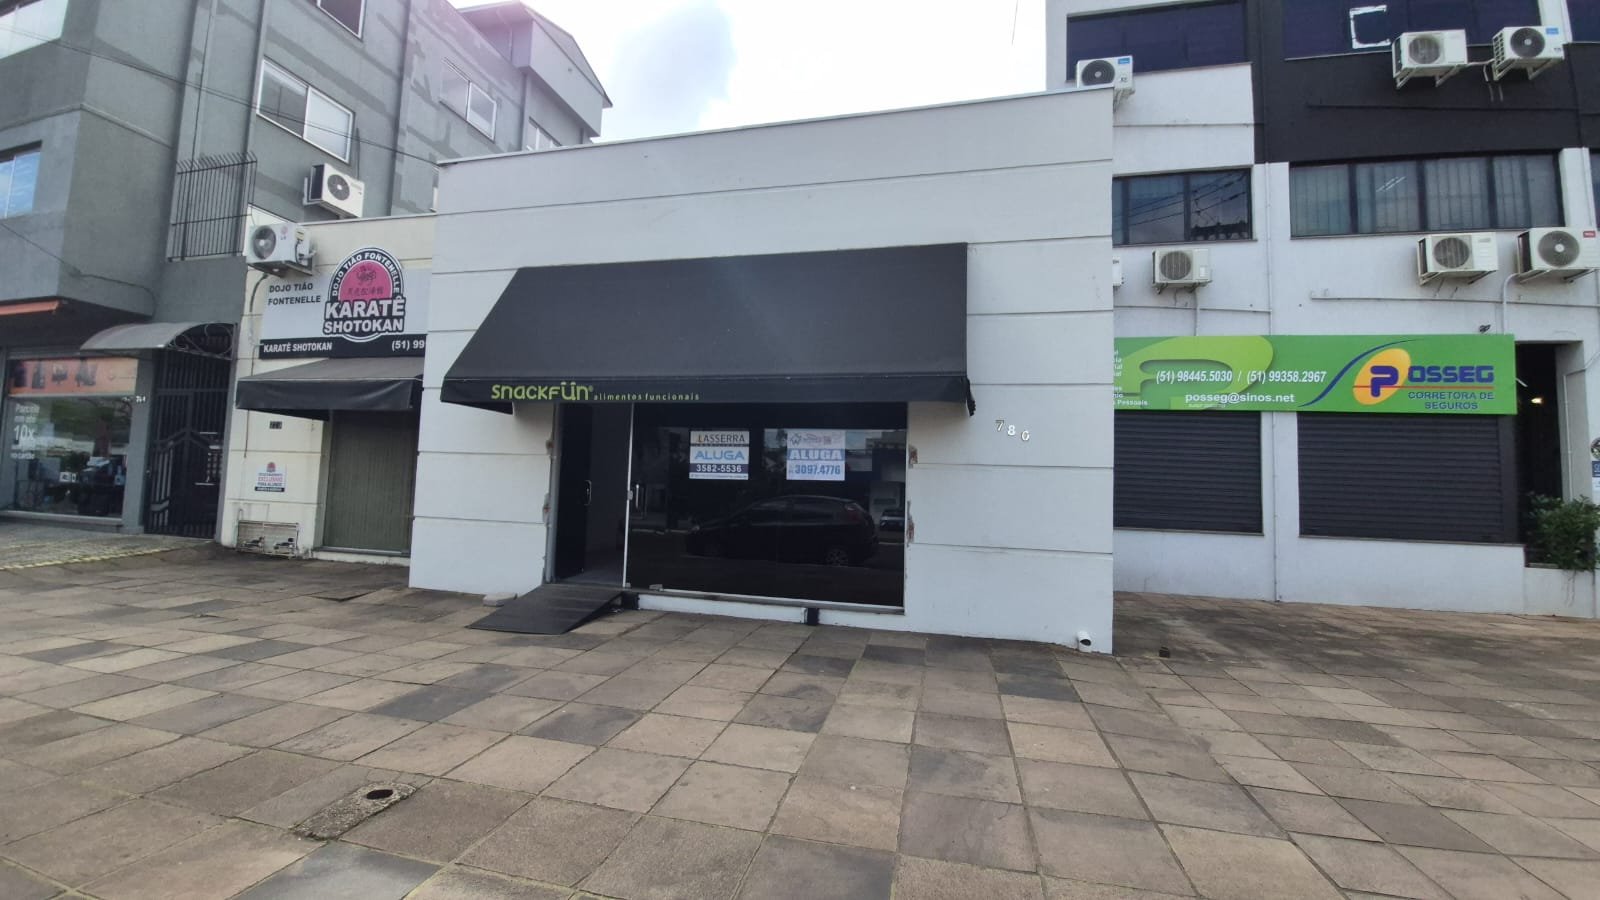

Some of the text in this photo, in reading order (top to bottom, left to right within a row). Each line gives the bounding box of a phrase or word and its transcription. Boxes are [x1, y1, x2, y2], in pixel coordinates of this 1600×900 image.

[332, 271, 344, 296] DOJO
[364, 252, 400, 293] FONTENELLE
[269, 285, 291, 293] DOJO
[268, 295, 321, 306] FONTENELLE
[325, 295, 404, 318] KARATÊ
[324, 318, 403, 333] SHOTOKAN
[292, 341, 333, 352] SHOTOKAN
[392, 339, 425, 352] (51) 99
[1156, 370, 1327, 384] (51) 98445.5030 / (51) 99358.2967
[1370, 365, 1494, 398] POSSEG
[593, 392, 642, 401] alimentos
[645, 392, 700, 401] funcionais
[1185, 392, 1295, 404] posseg@sinos.net
[1408, 391, 1494, 400] CORRETORA DE
[1425, 401, 1478, 410] SEGUROS
[697, 433, 745, 443] LASSERRA
[694, 449, 745, 460] ALUGA
[789, 448, 842, 460] ALUGA
[696, 463, 742, 473] 3582-5536
